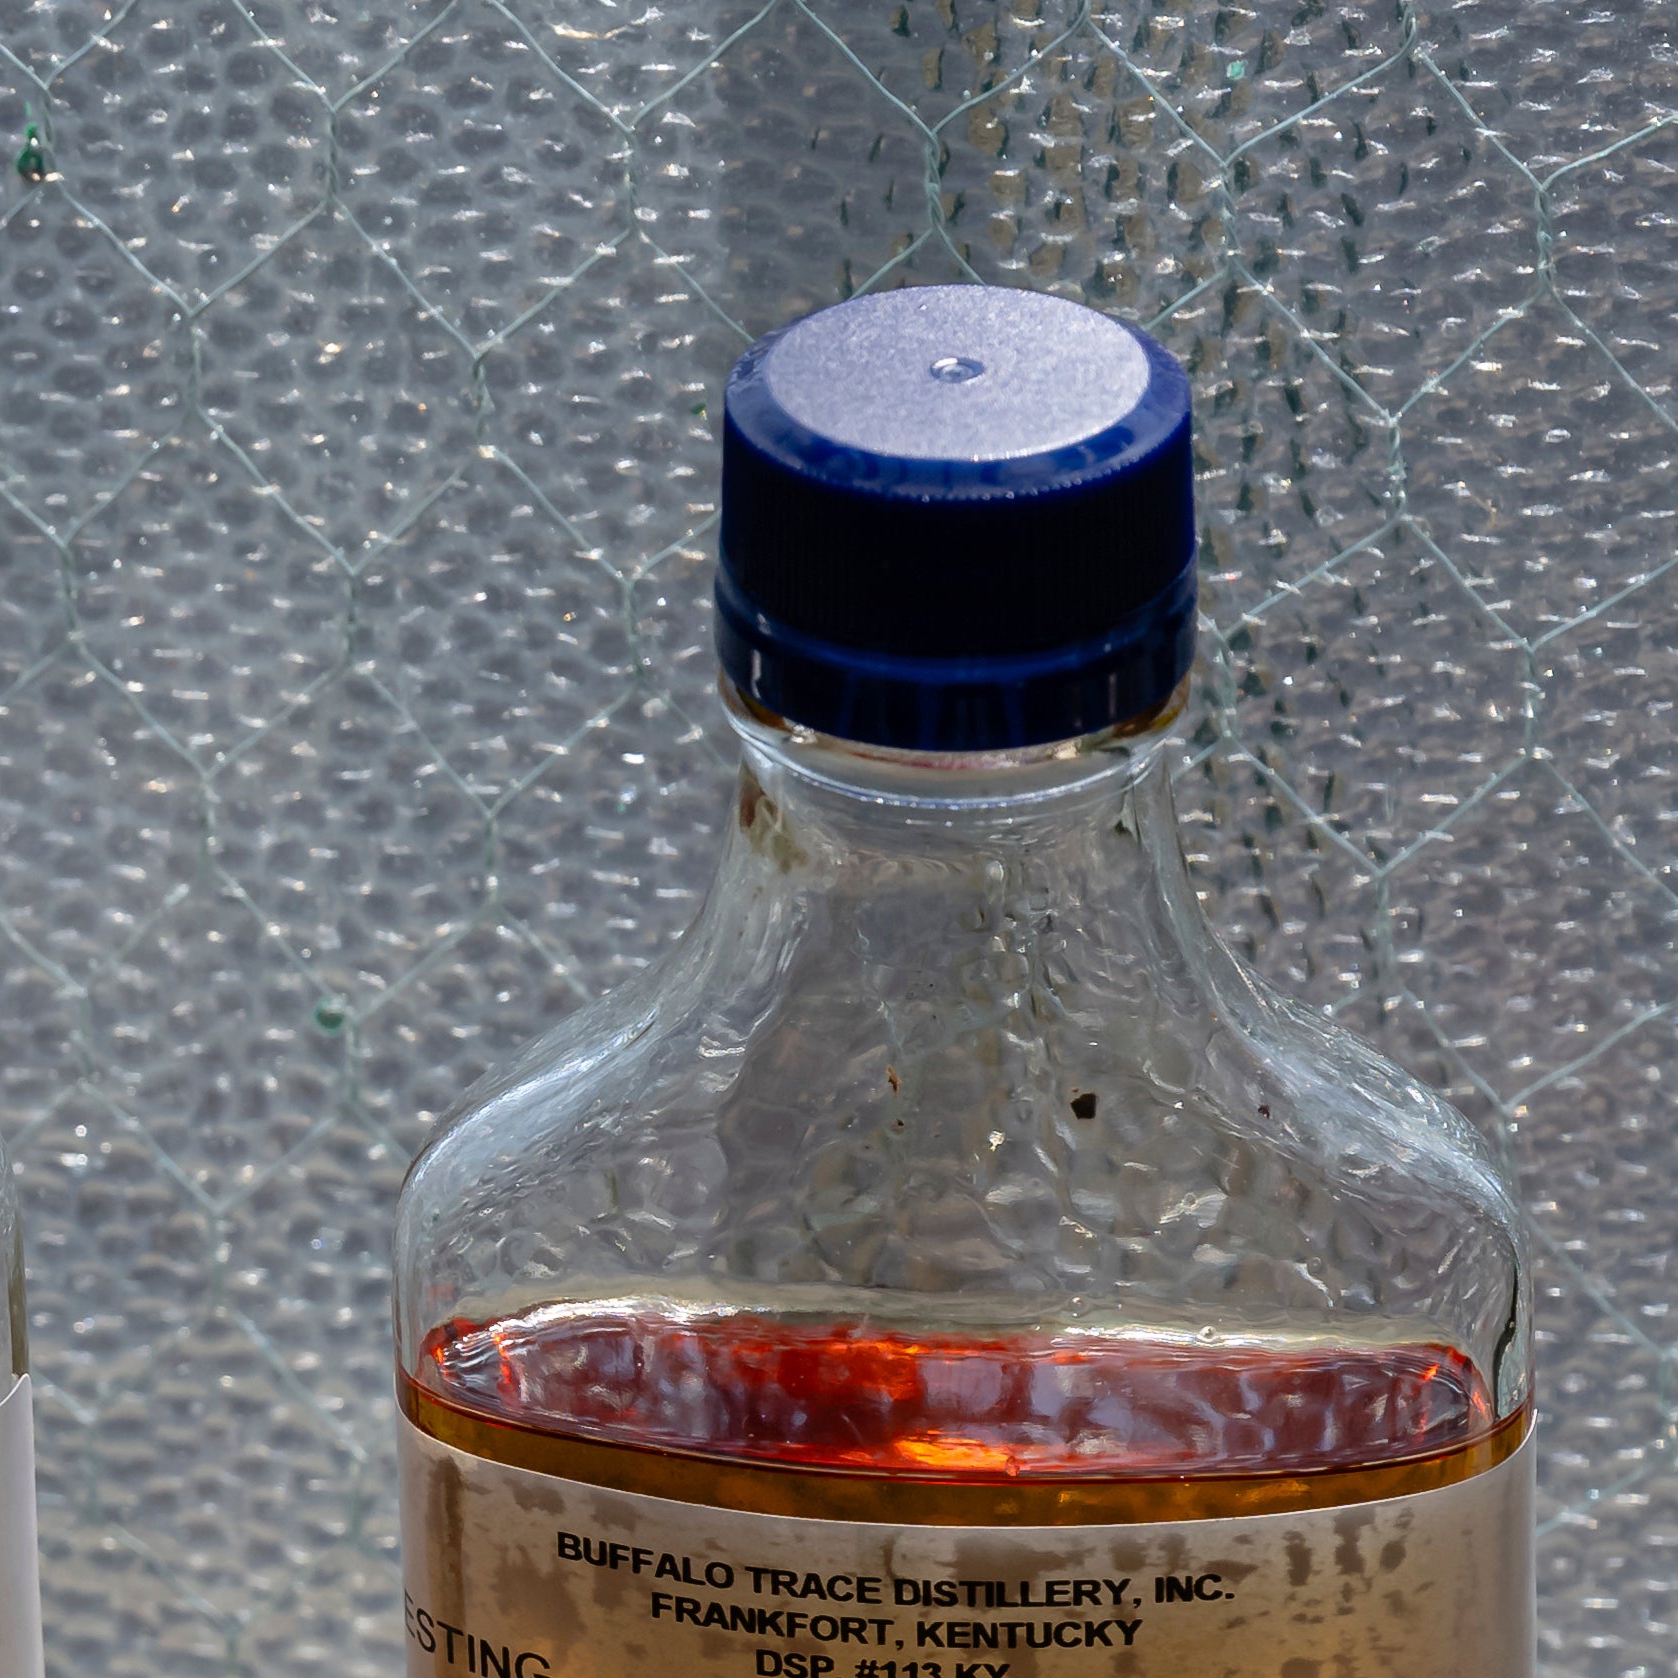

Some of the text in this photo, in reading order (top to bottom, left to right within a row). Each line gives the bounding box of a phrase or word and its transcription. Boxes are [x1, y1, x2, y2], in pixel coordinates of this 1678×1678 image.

[557, 1531, 1236, 1610] BUFFALO TRACE DISTILLERY, INC.
[651, 1591, 1143, 1651] FRANKFORT, KENTUCKY
